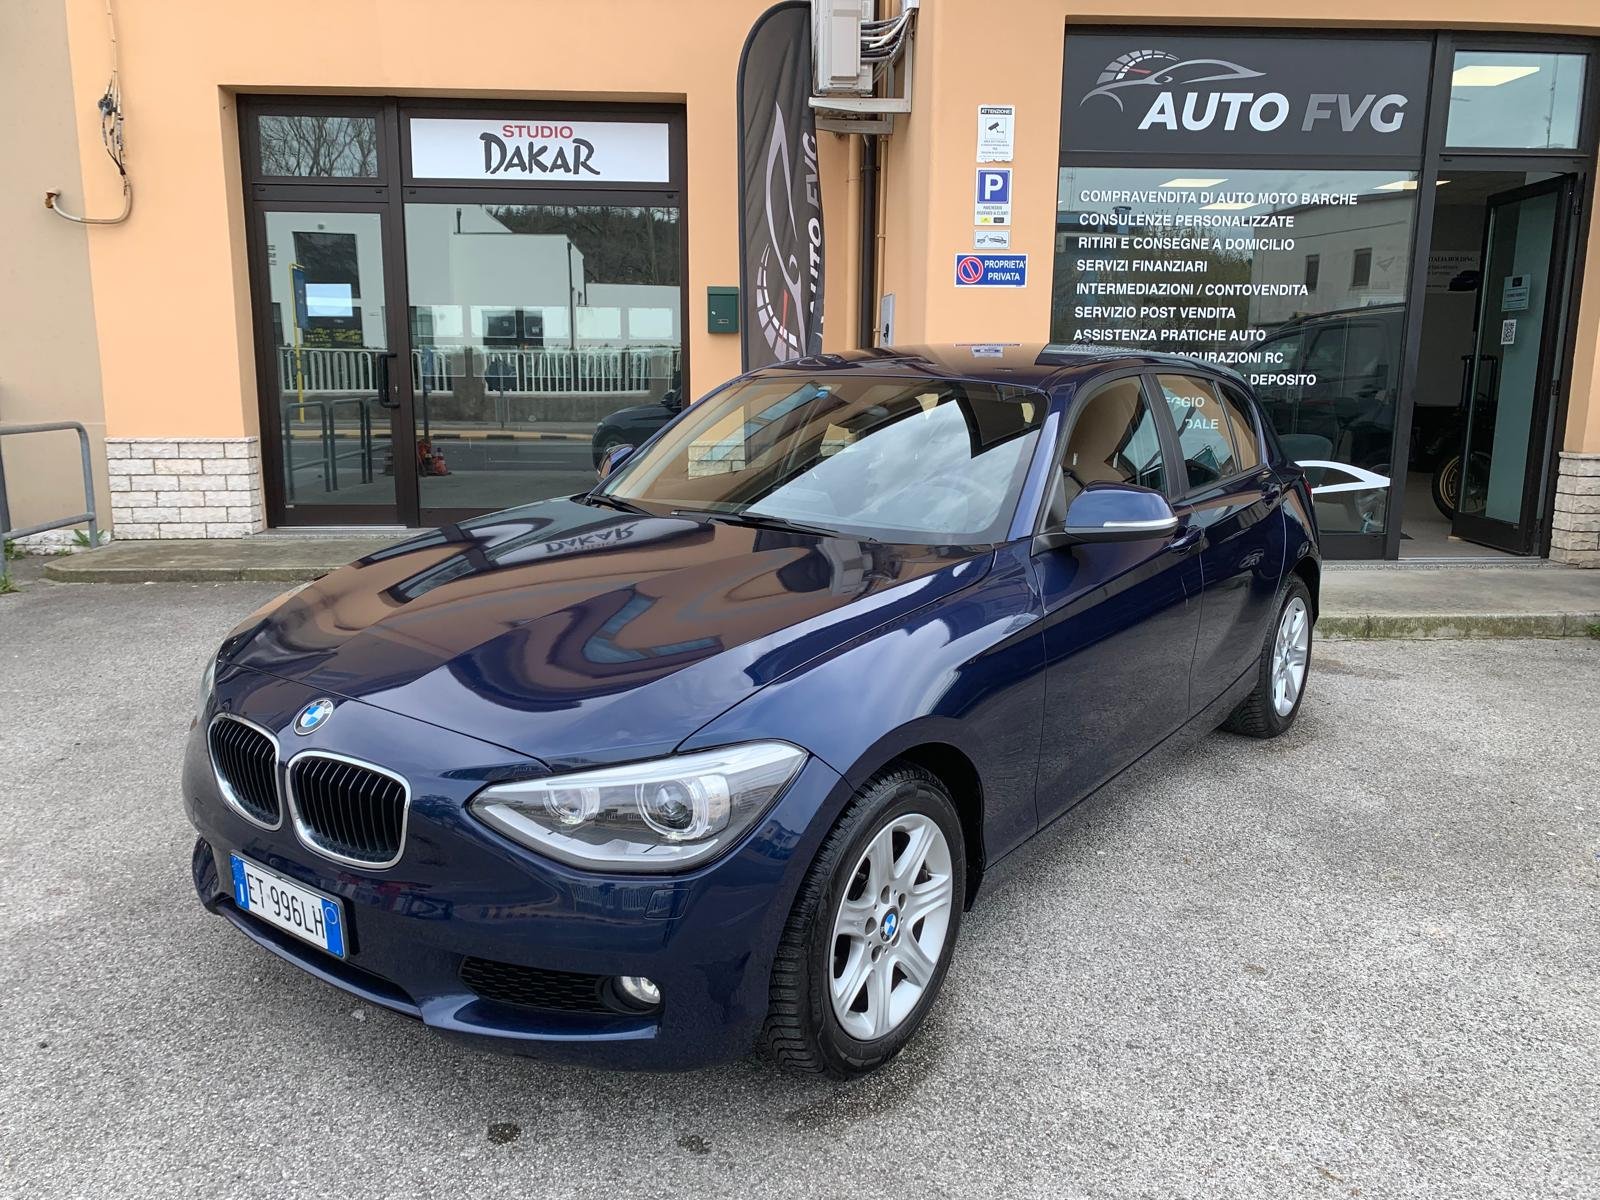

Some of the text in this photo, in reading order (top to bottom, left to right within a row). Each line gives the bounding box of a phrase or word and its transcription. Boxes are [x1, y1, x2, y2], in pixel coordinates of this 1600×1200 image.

[1137, 92, 1409, 133] AUTO FVG
[502, 124, 574, 139] STUDIO
[479, 132, 601, 175] DAKAR
[984, 173, 1004, 200] P
[1080, 190, 1358, 206] COMPRAVENDITA DI AUTO MOTO BARCHE
[1079, 213, 1295, 228] CONSULENZE PERSONALIZZATE
[1078, 237, 1295, 251] RITIRI E CONSEGNE A DOMICILIO
[1076, 259, 1208, 273] SERVIZI FINANZIARI
[988, 272, 1021, 281] PRIVATA
[1076, 283, 1309, 297] INTERMEDIAZIONI / CONTOVENDITA
[1074, 306, 1236, 320] SERVIZIO POST VENDITA
[1073, 328, 1267, 342] ASSISTENZA PRATICHE AUTO
[1169, 351, 1284, 365] URAZIONI RC
[1249, 373, 1317, 386] DEPOSITO
[246, 872, 326, 940] ET 996LH
